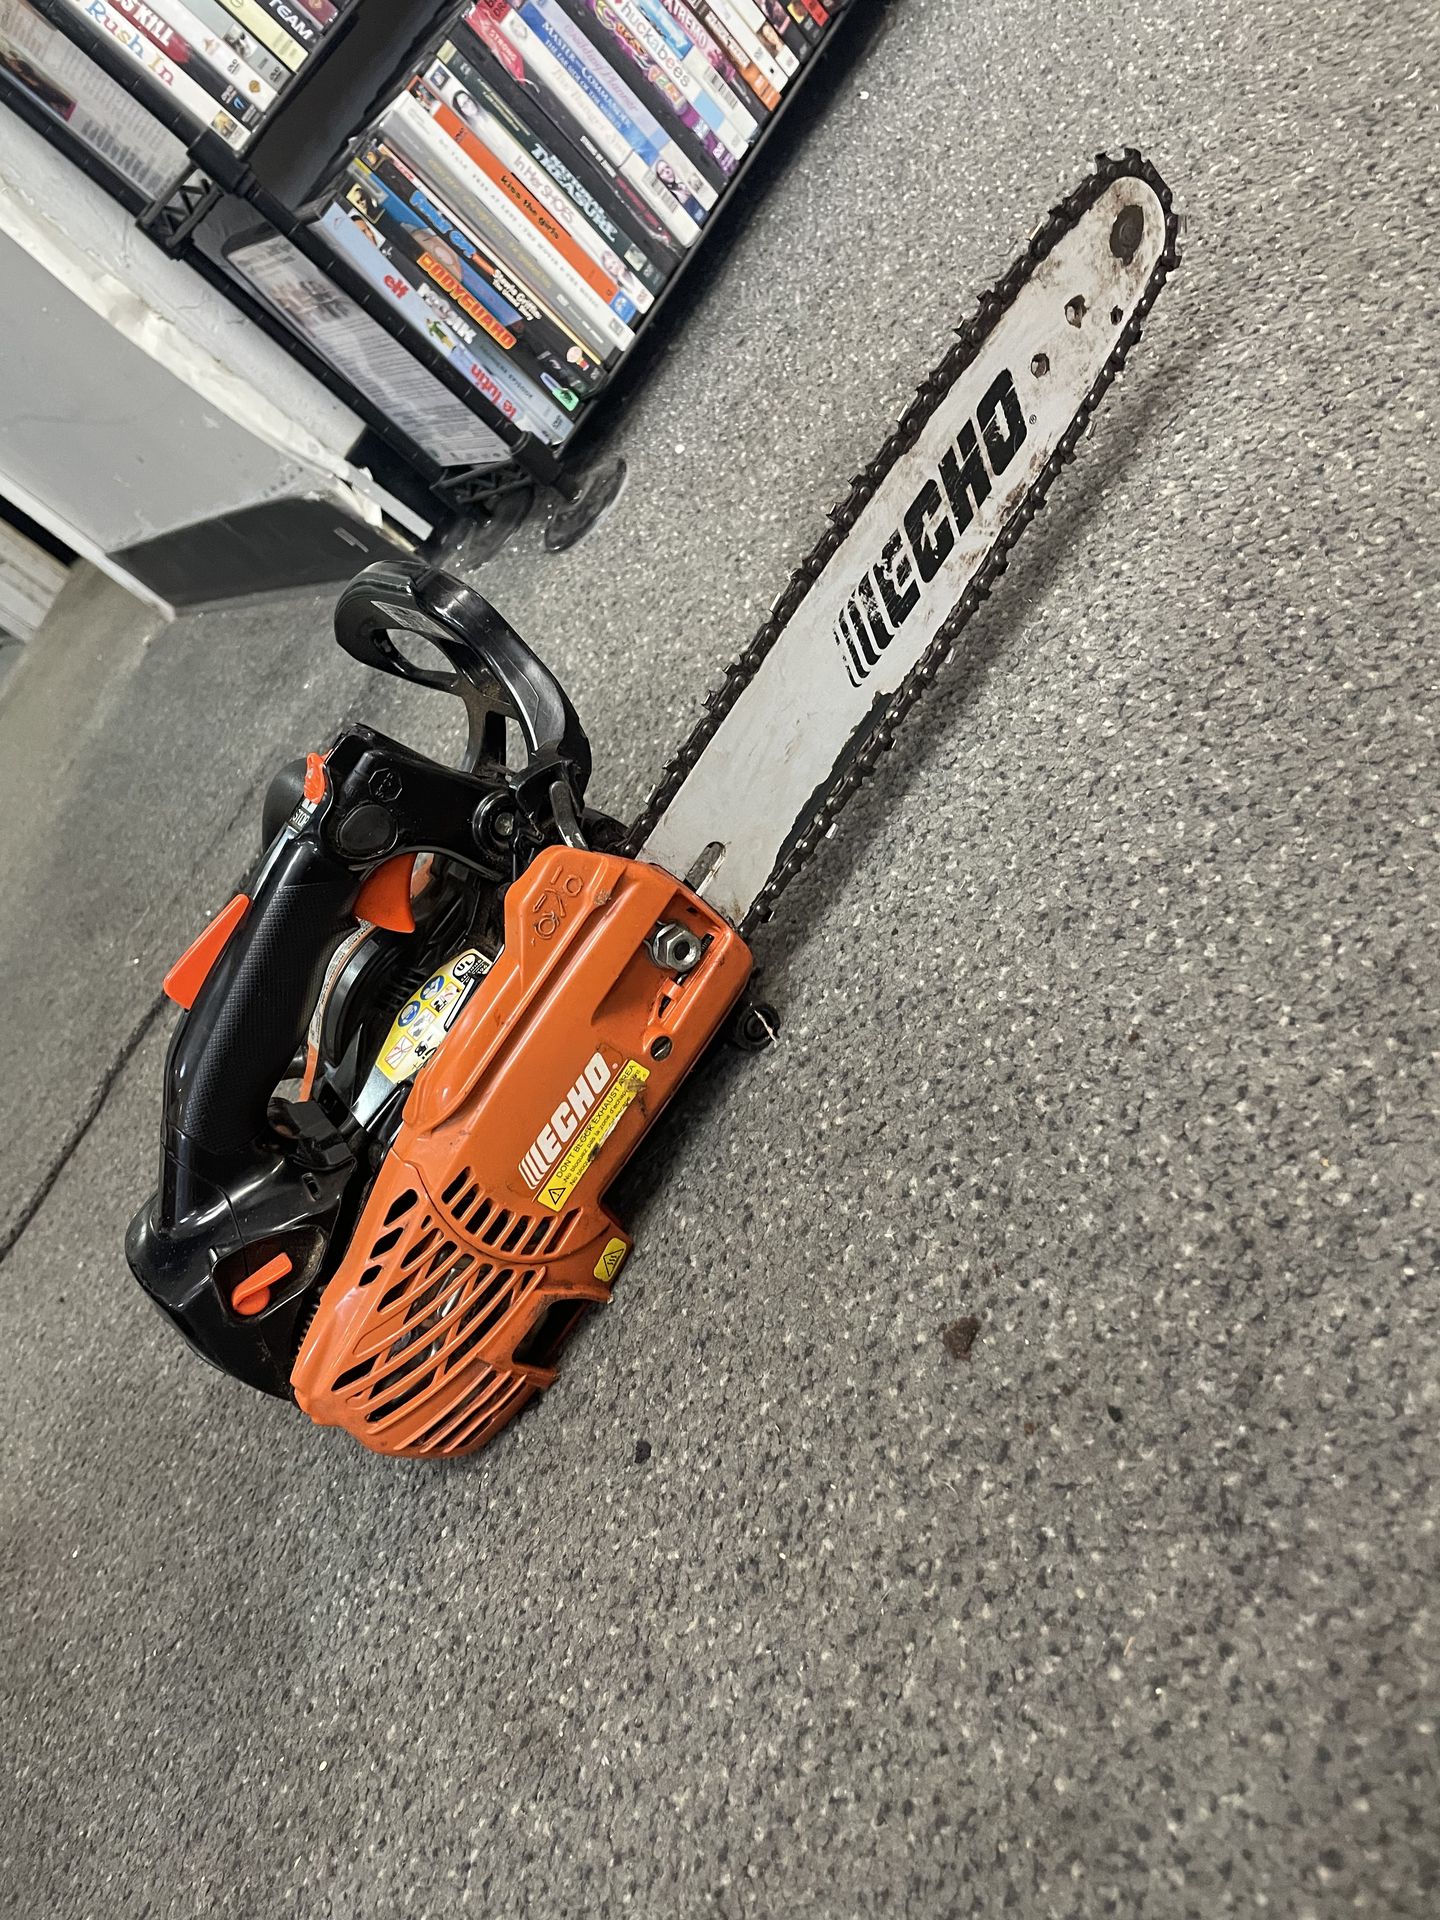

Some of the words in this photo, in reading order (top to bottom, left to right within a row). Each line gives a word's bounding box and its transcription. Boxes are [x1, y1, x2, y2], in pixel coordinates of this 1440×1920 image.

[85, 0, 144, 59] Rush
[147, 52, 176, 86] In
[132, 3, 174, 46] KILL
[487, 28, 517, 62] STRONG
[619, 2, 692, 88] huckabees
[541, 20, 577, 62] MASTER
[579, 66, 632, 128] COMMANDER
[512, 155, 528, 172] In
[499, 174, 524, 200] kiss
[521, 196, 541, 216] the
[530, 143, 618, 242] TREASURE
[381, 272, 409, 299] elf
[415, 252, 516, 351] BODYGUARD
[467, 362, 502, 405] lutin
[500, 398, 518, 423] le
[848, 368, 1027, 650] ECHO
[290, 808, 310, 828] STOP
[456, 957, 473, 972] UL
[528, 1052, 611, 1178] ECHO
[555, 1152, 575, 1178] DON'T
[573, 1123, 595, 1152] BLOCK
[592, 1086, 620, 1124] EXHAUST
[616, 1062, 636, 1087] AREA
[568, 1146, 589, 1173] bloquez
[586, 1136, 597, 1149] pas
[593, 1128, 601, 1136] la
[598, 1113, 611, 1130] zone
[569, 1176, 577, 1185] No
